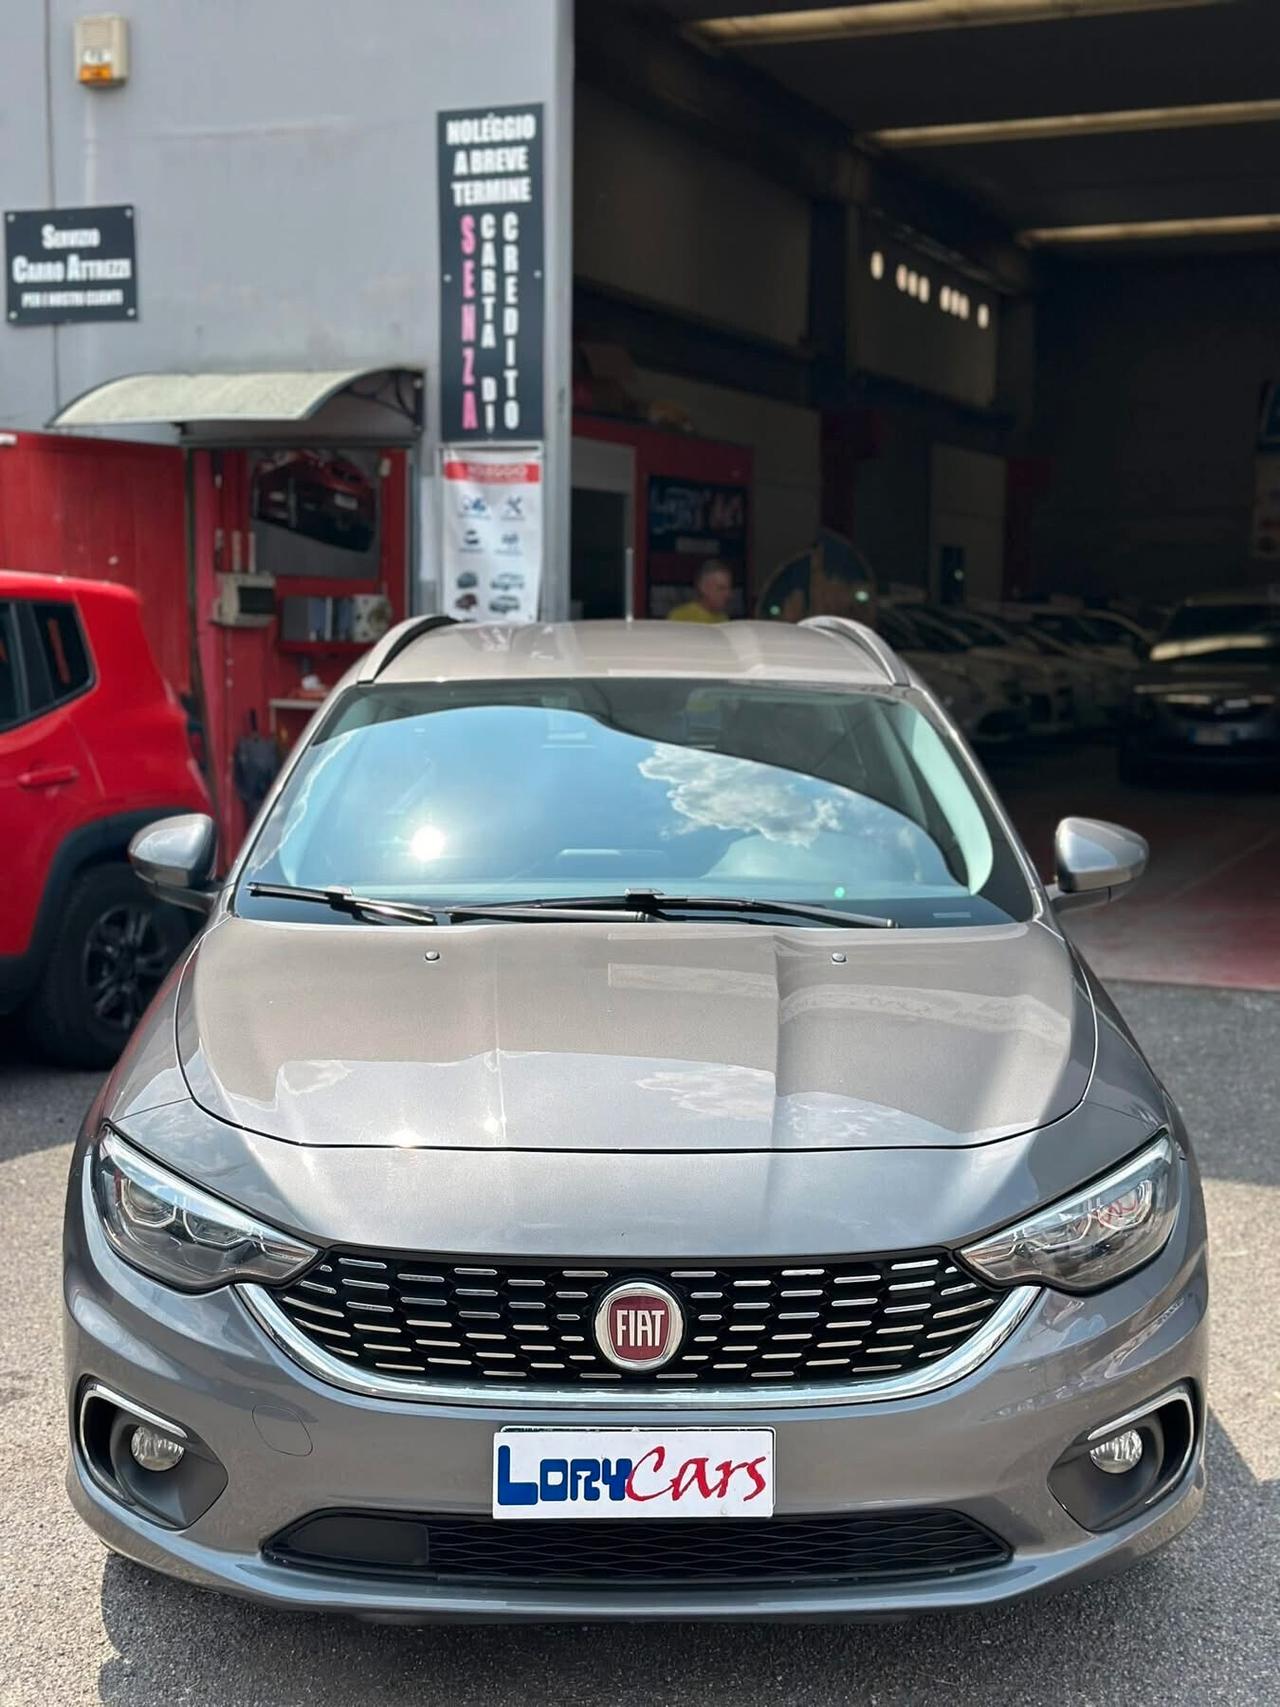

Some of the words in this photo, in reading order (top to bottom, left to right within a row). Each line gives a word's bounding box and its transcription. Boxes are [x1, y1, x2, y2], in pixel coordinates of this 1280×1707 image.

[451, 176, 532, 207] TERMINE
[453, 150, 468, 175] A
[469, 145, 529, 174] BREVE
[461, 214, 478, 429] SENZA
[481, 213, 496, 348] CARTA
[503, 211, 519, 429] CREDITO
[616, 1310, 665, 1346] FIAT
